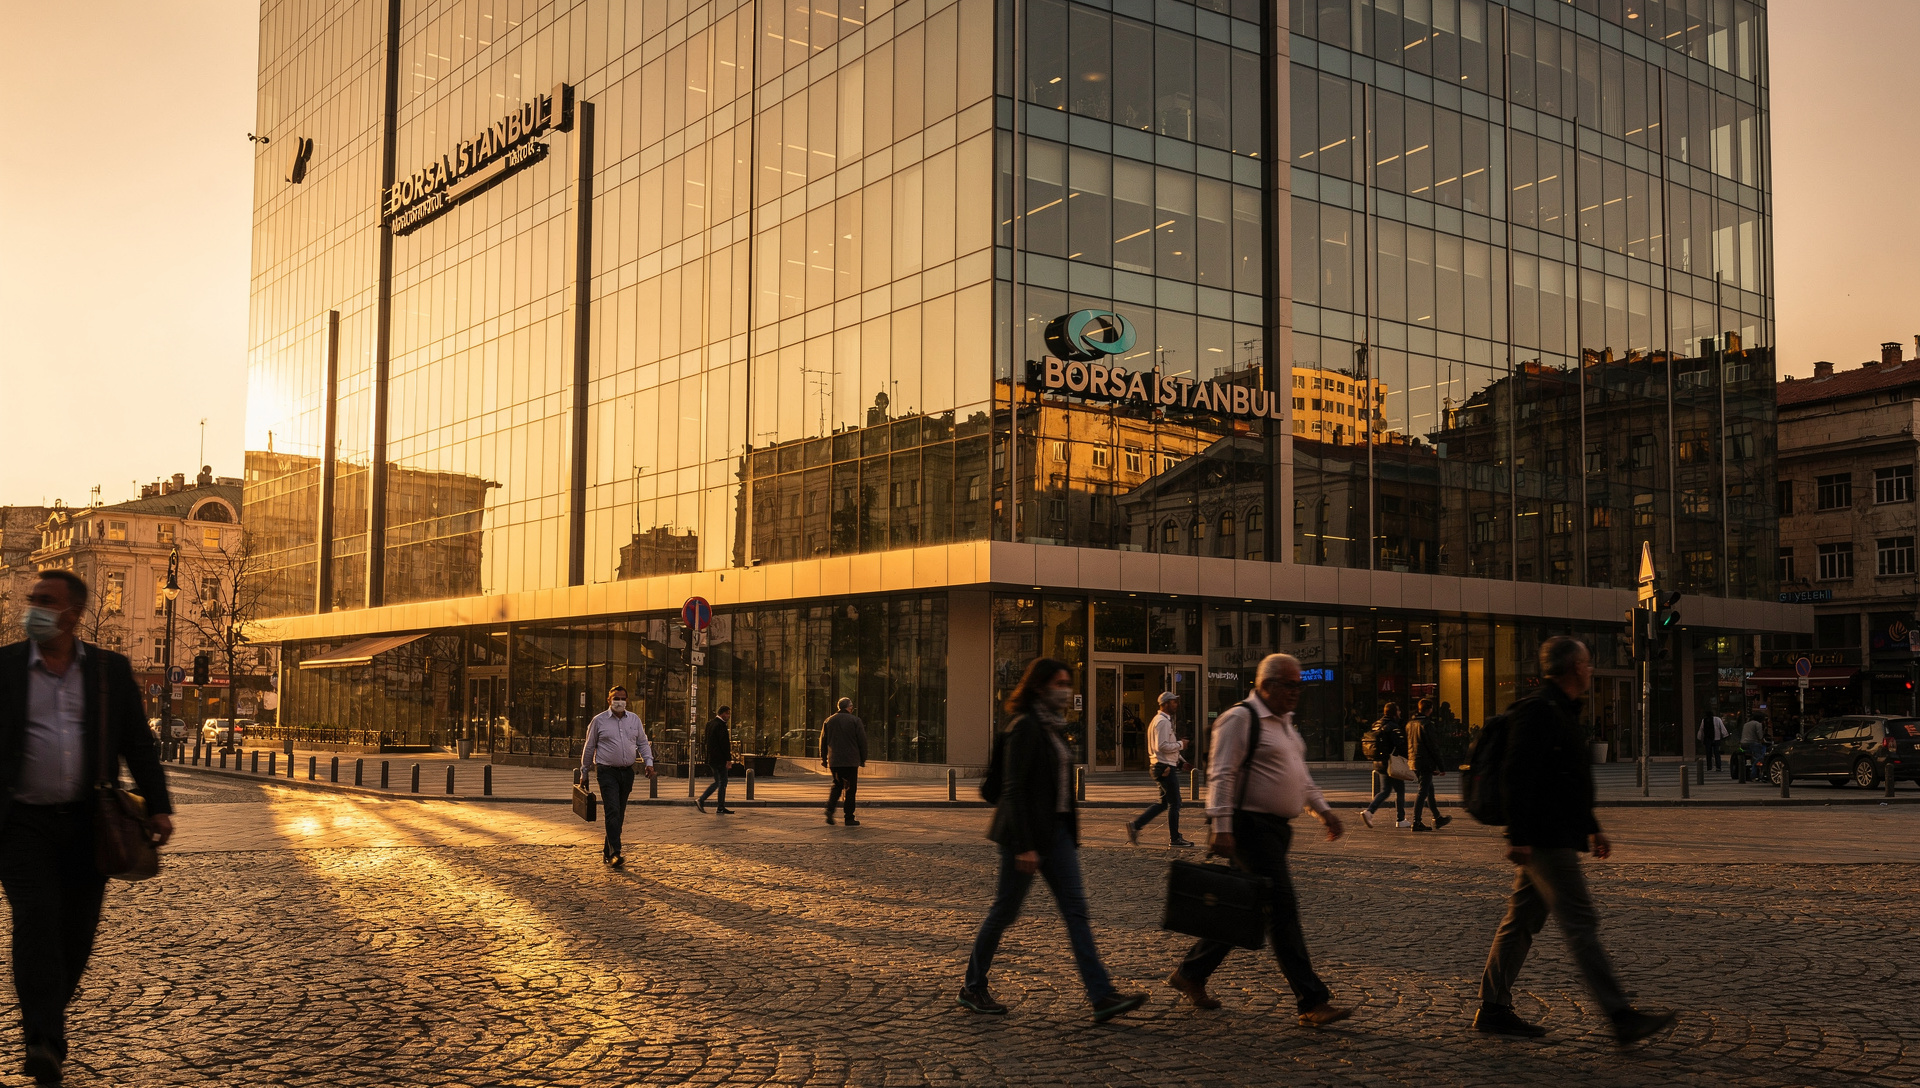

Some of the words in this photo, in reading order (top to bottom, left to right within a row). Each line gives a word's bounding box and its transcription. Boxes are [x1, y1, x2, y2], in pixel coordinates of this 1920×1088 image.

[391, 155, 448, 215] BORSA
[1044, 355, 1149, 402] BORSA
[1153, 364, 1285, 421] İSTANBUL
